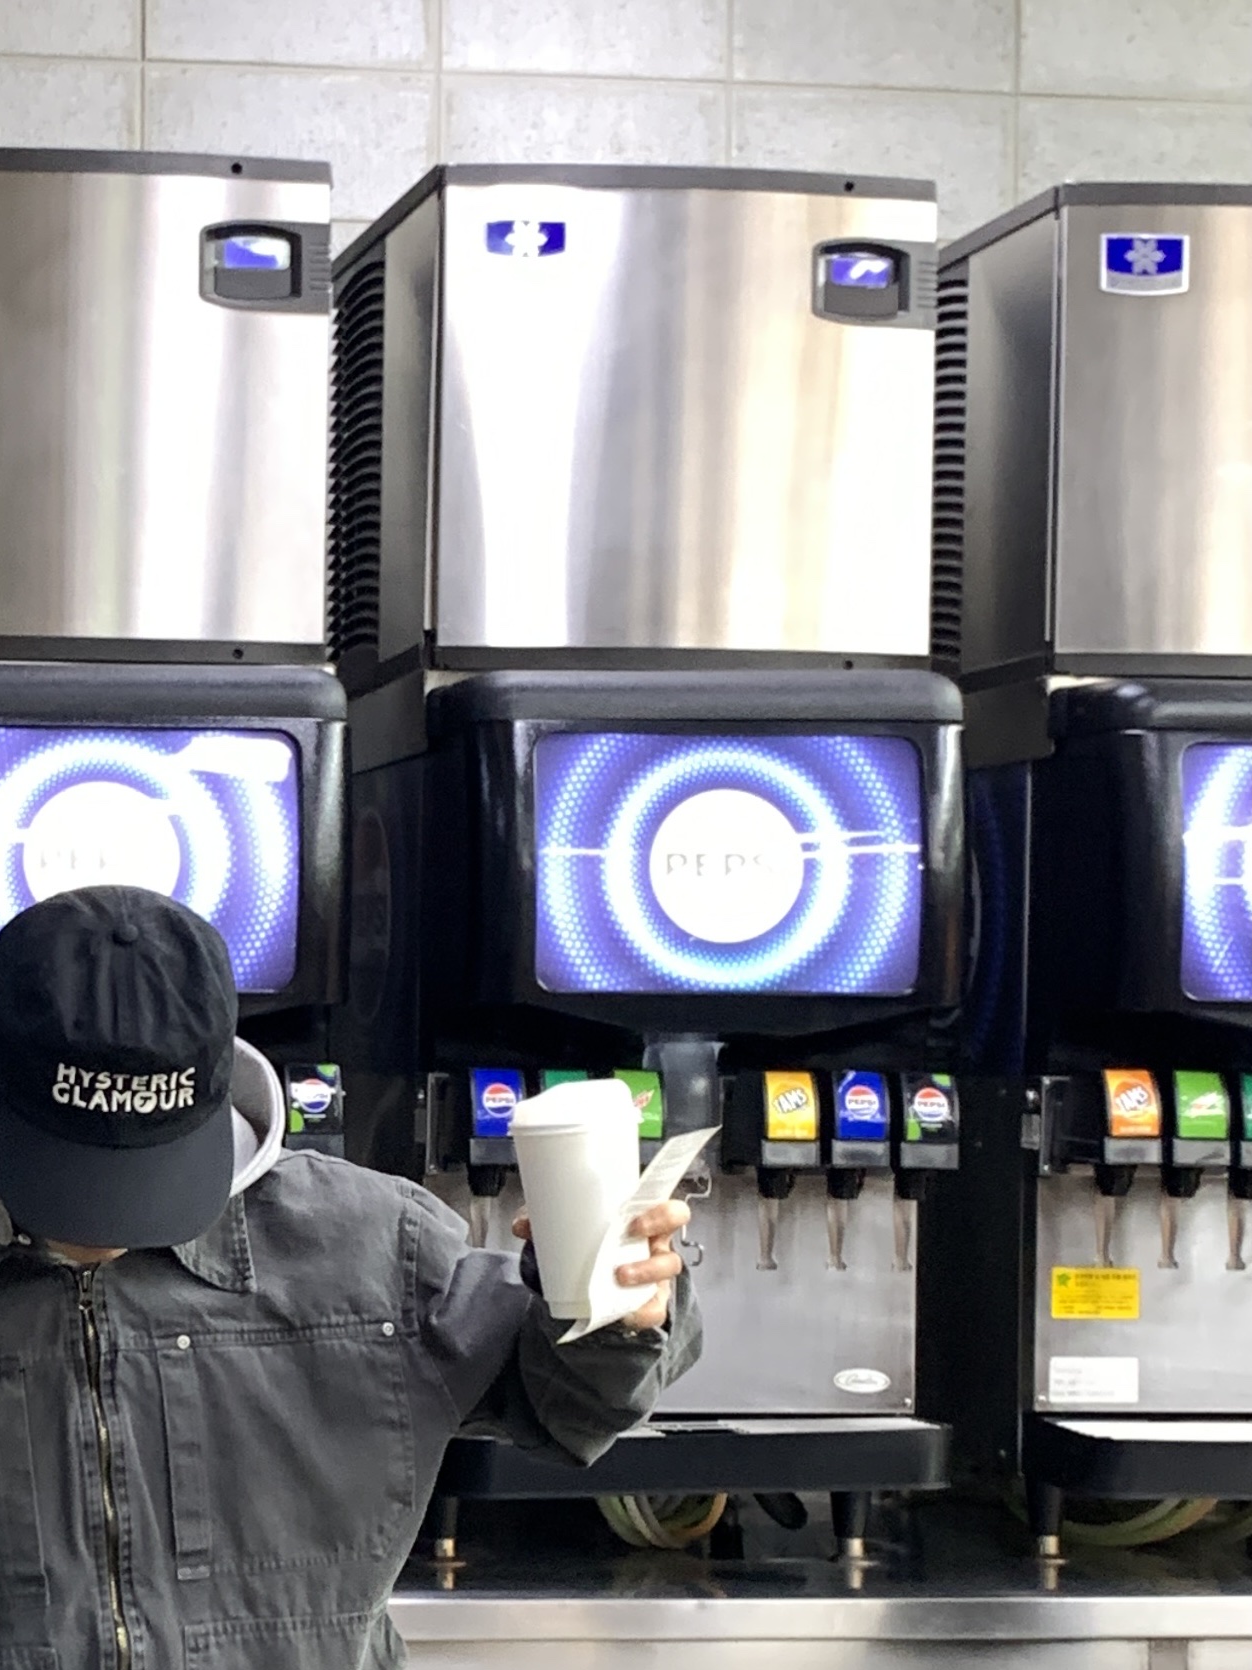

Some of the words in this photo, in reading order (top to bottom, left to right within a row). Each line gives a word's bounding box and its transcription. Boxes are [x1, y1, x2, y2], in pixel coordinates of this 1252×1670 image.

[666, 853, 776, 876] PEP
[56, 1062, 196, 1092] HYSTERIC
[52, 1082, 195, 1114] GLAMOUR
